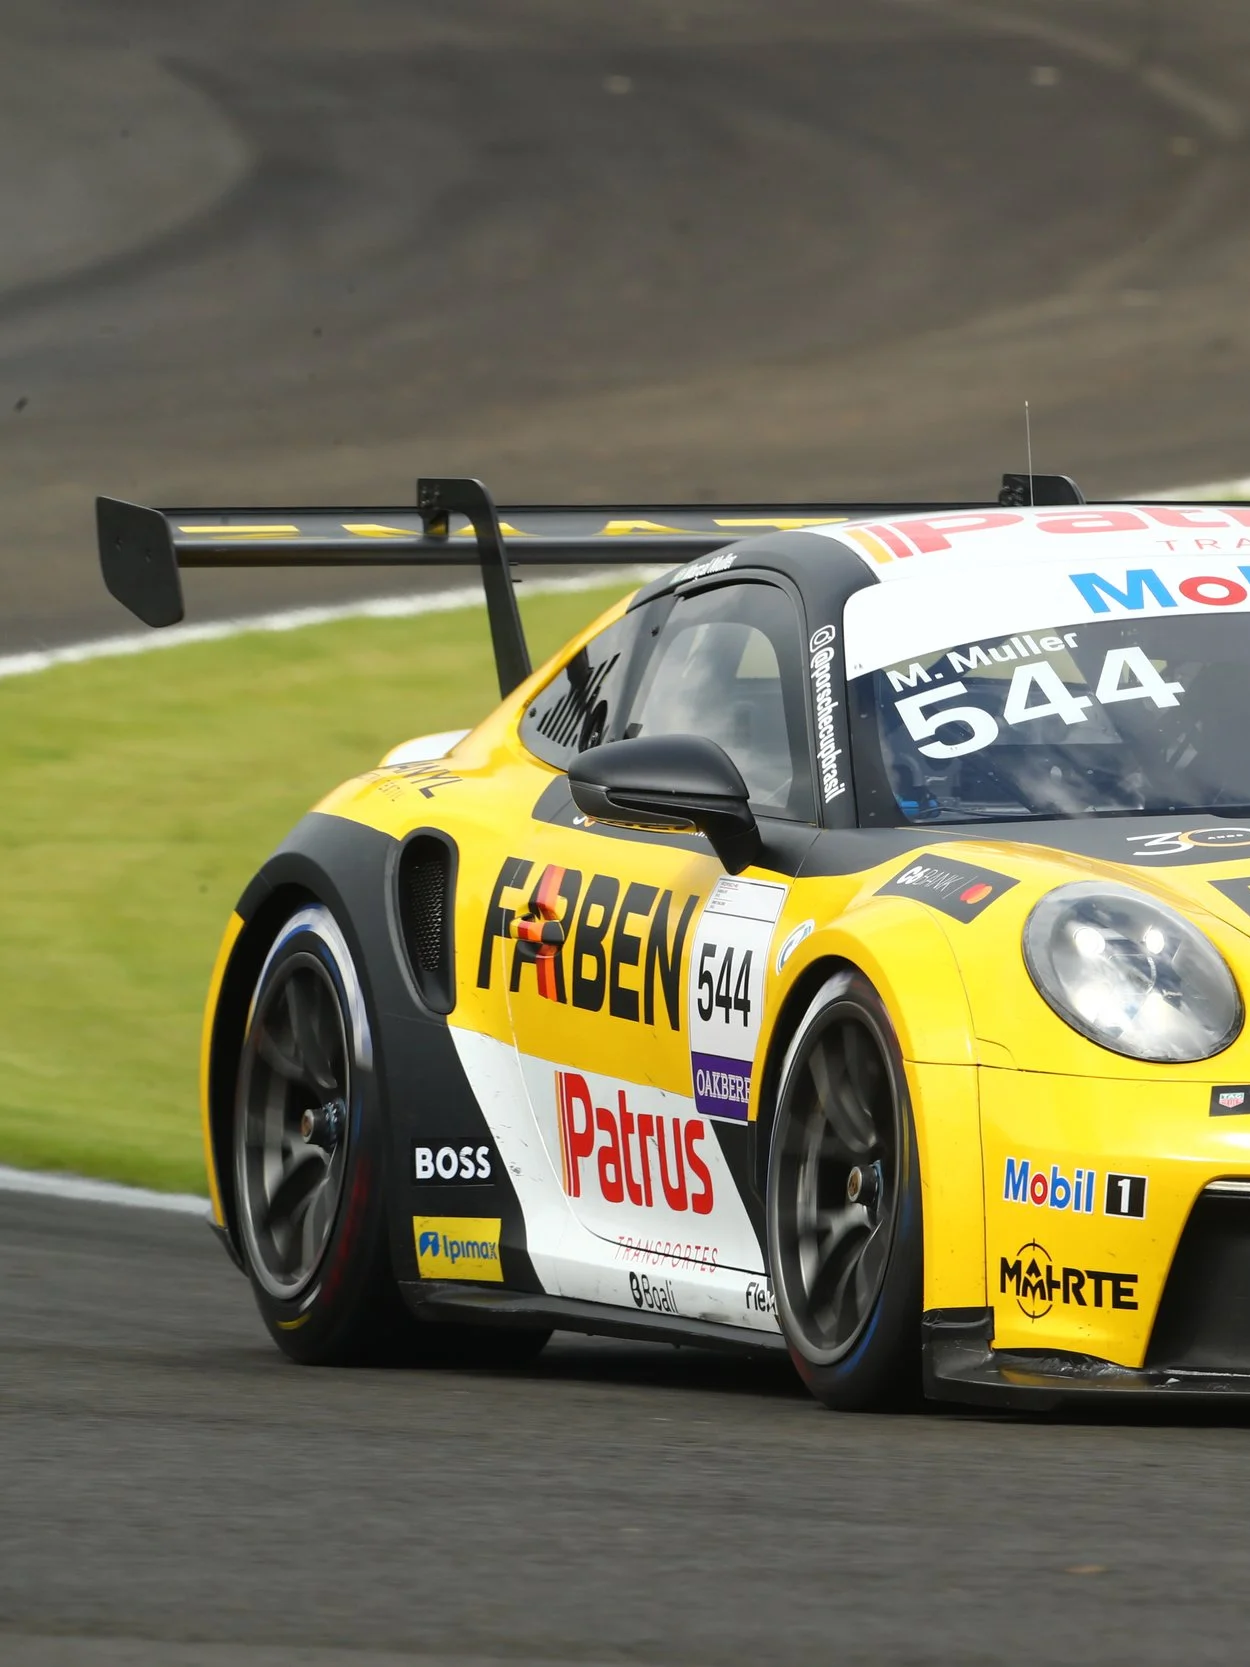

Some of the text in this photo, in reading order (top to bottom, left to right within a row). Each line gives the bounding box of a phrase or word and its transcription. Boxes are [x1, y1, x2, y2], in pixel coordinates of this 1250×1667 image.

[885, 632, 1079, 692] M. Muller
[810, 647, 846, 804] @porschecupbrasil
[893, 646, 1186, 759] 544
[476, 856, 700, 1031] FARBEN
[697, 943, 753, 1027] 544
[415, 1146, 491, 1180] BOSS
[564, 1072, 714, 1215] Patrus
[1003, 1157, 1131, 1214] Mobil 1
[615, 1236, 720, 1273] TRANSPORTES
[641, 1274, 679, 1313] Boali
